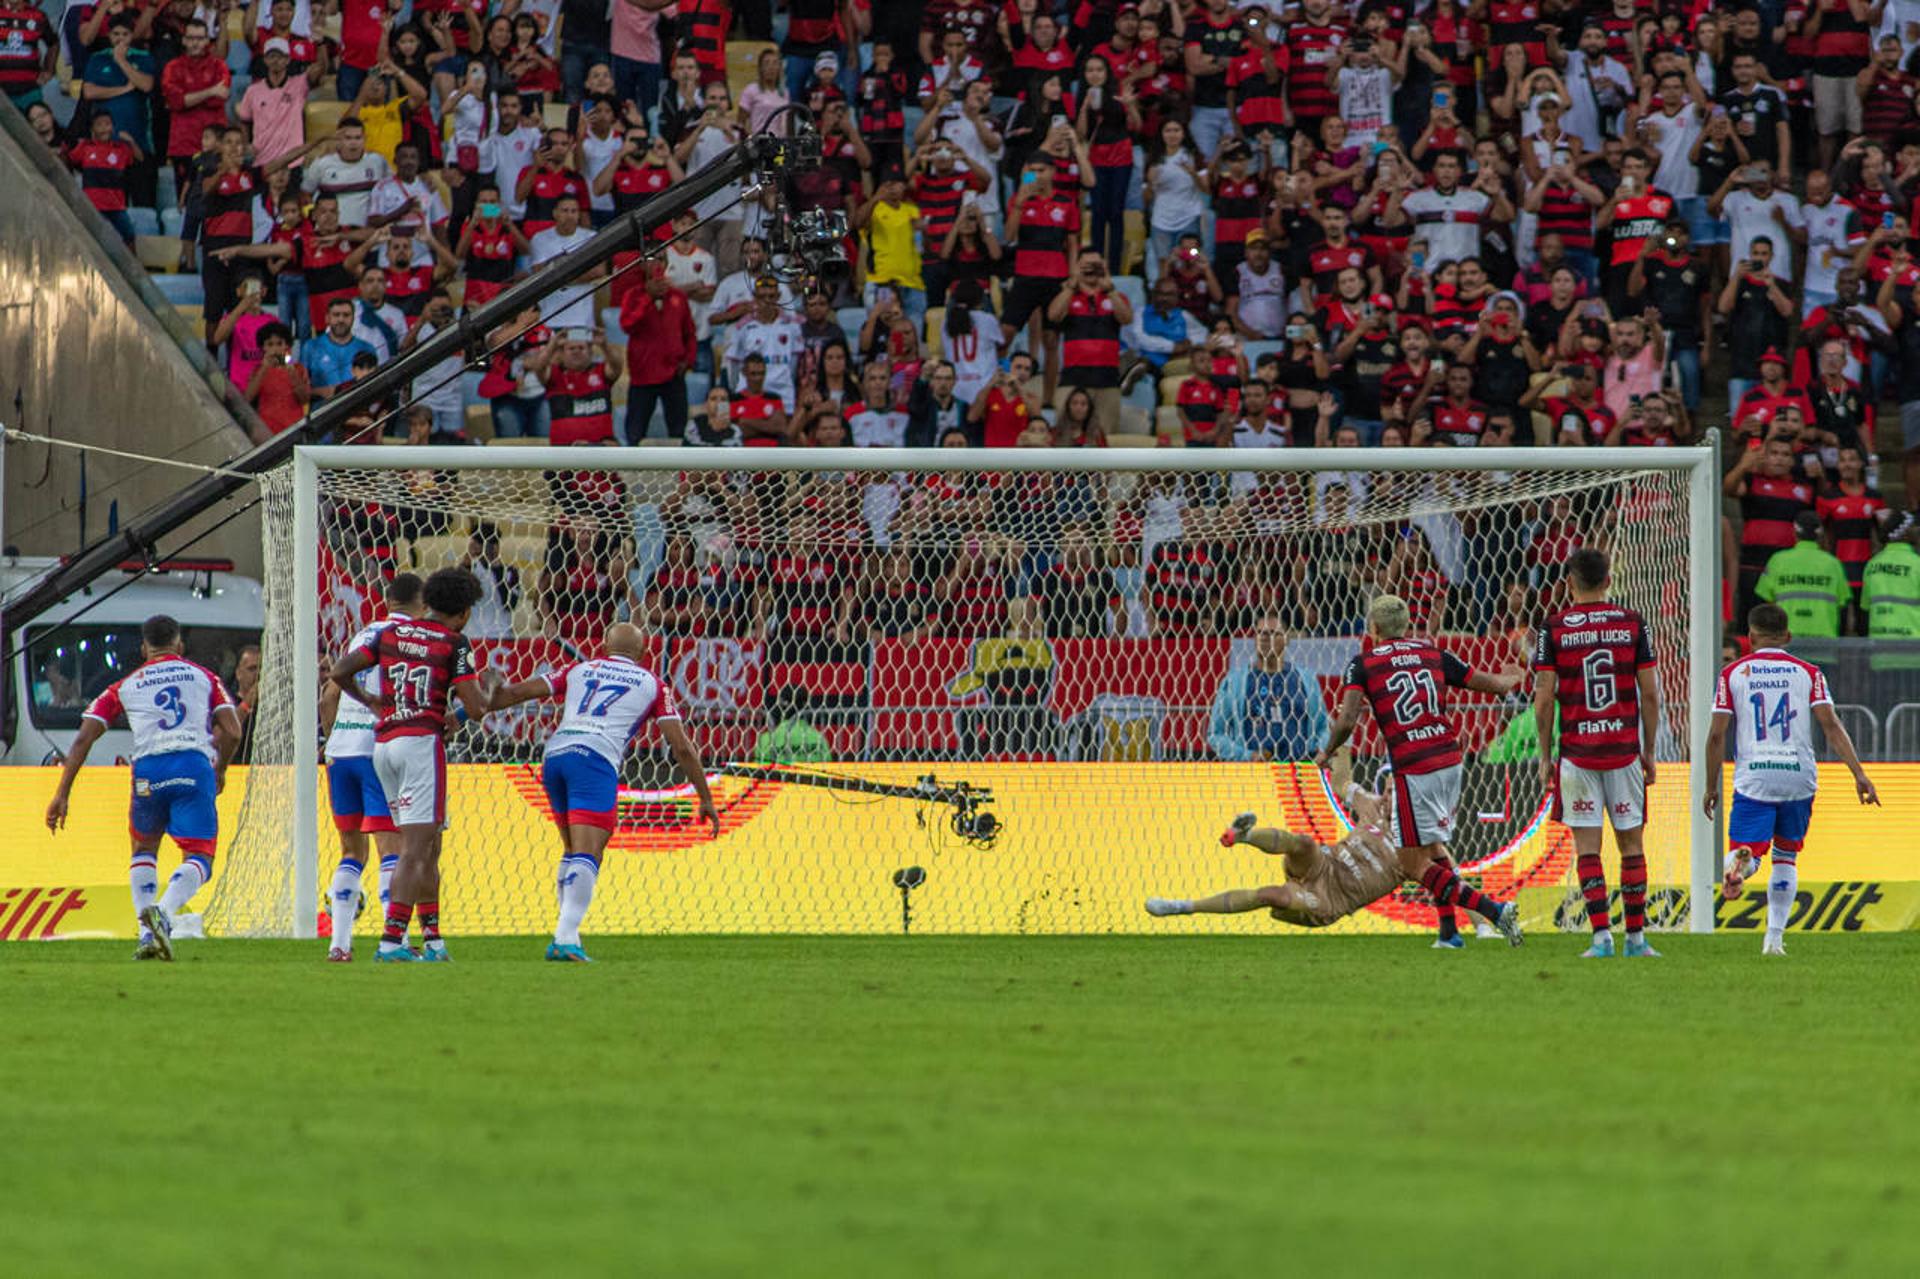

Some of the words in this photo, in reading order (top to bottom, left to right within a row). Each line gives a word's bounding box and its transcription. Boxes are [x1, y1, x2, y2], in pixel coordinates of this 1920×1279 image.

[1777, 574, 1833, 586] SUNSET
[1561, 630, 1599, 648] AYRTON
[1600, 629, 1632, 643] LUCAS
[1391, 654, 1422, 667] PEDRO
[1751, 665, 1798, 675] brisanet
[135, 674, 195, 690] LANDAZURI
[387, 662, 432, 712] 11
[1583, 648, 1617, 713] 6
[1749, 679, 1789, 690] RONALD
[576, 679, 631, 717] 17
[1385, 669, 1440, 726] 21
[154, 685, 187, 731] 3
[1749, 691, 1797, 743] 14
[1572, 798, 1595, 812] abc
